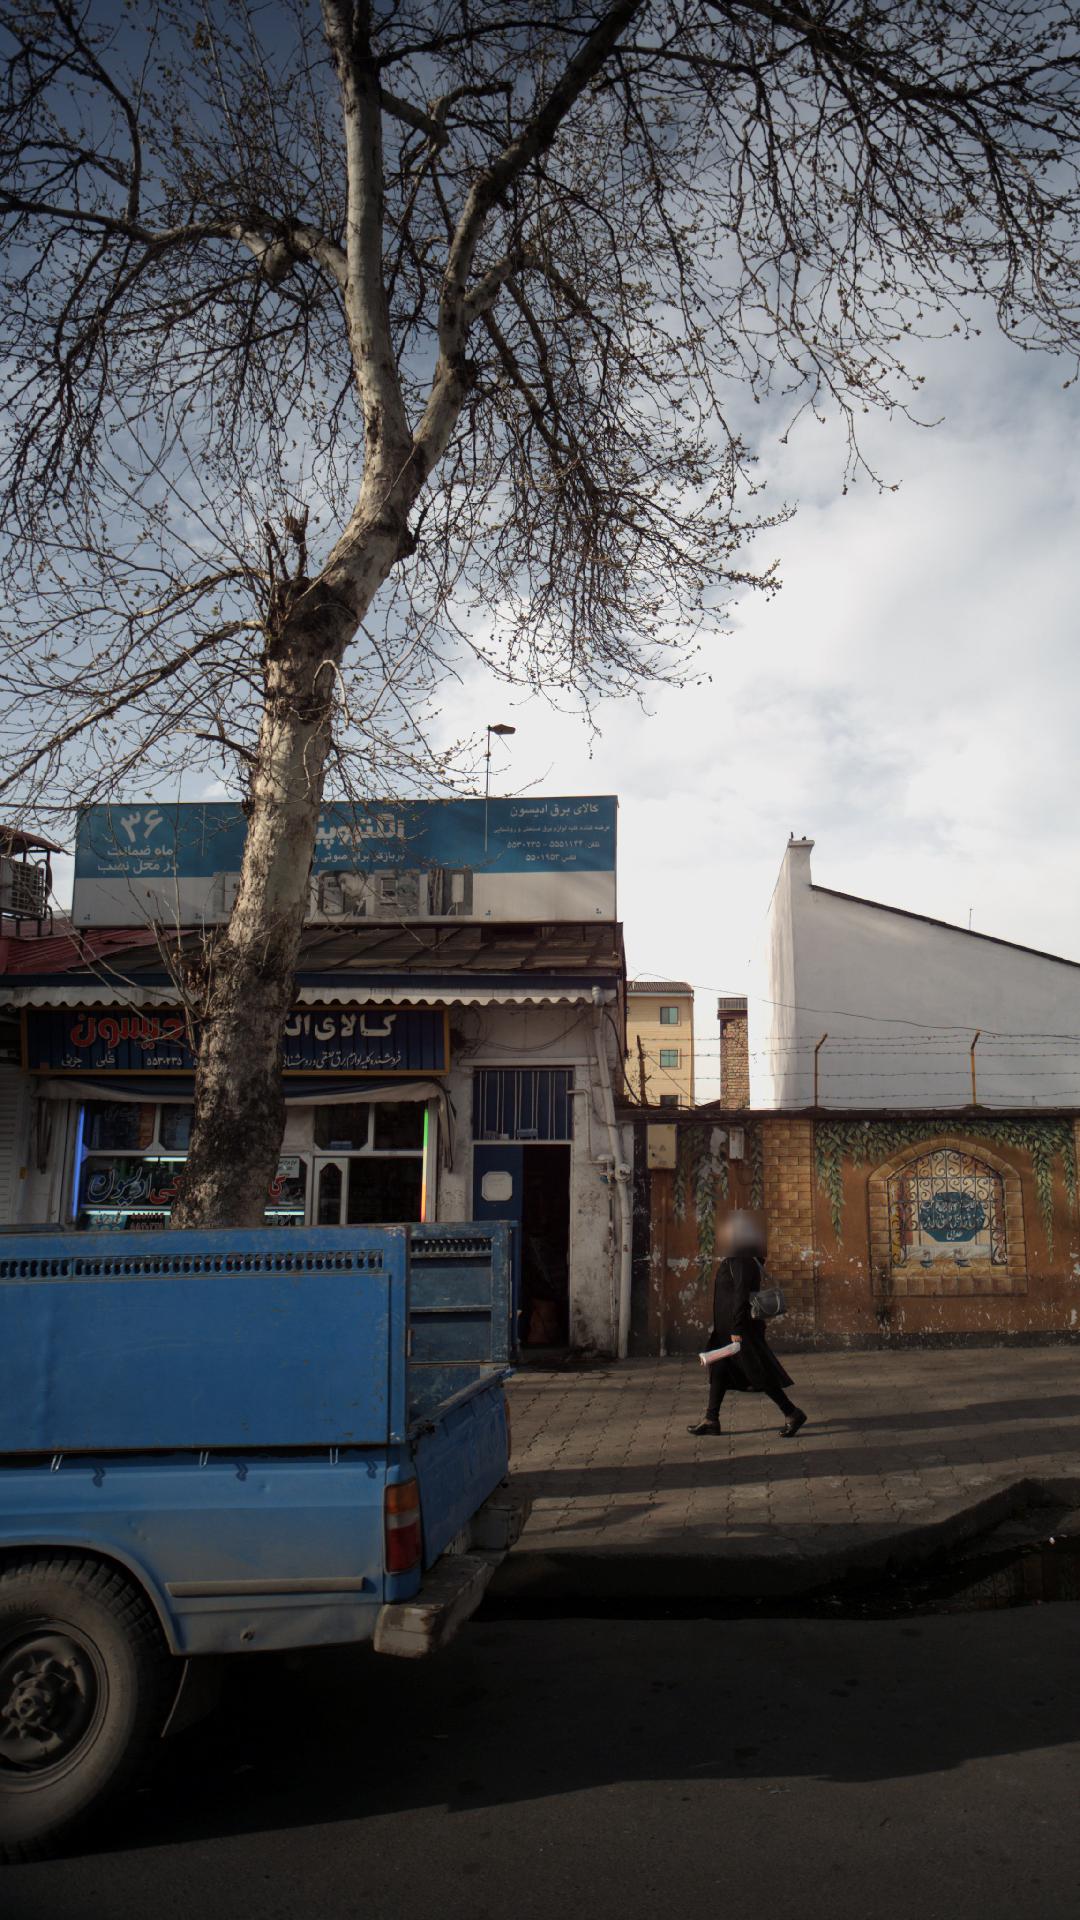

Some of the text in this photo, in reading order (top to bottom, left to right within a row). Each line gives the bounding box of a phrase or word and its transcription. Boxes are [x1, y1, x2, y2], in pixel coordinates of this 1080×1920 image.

[510, 802, 599, 818] کالای برق ادیسون
[120, 809, 163, 843] ۳۶
[154, 844, 173, 856] ماه
[320, 851, 348, 863] صوتی
[133, 858, 160, 874] محل
[314, 1013, 398, 1040] کالای
